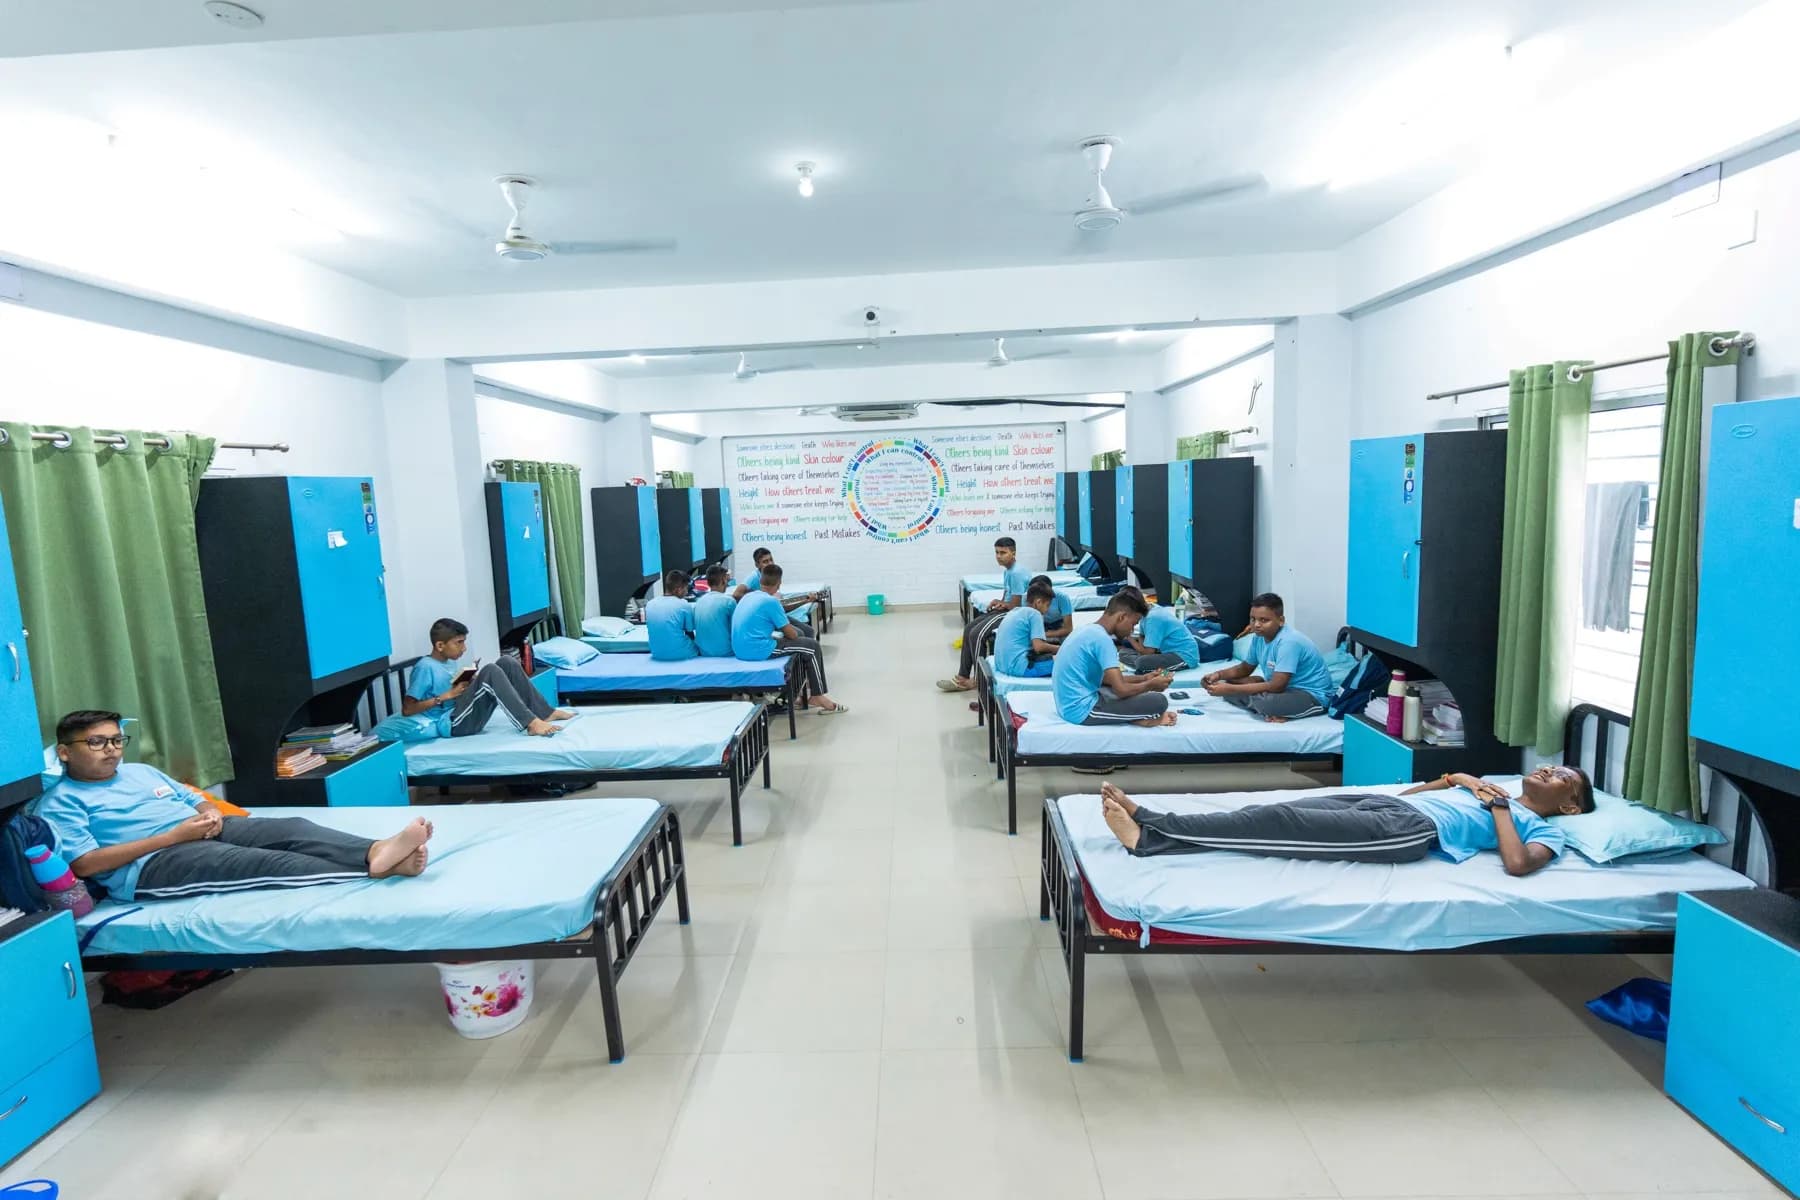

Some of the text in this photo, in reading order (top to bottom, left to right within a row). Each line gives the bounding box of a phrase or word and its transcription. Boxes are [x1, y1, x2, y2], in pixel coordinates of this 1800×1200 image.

[914, 437, 929, 450] What
[1013, 443, 1054, 456] Skin colour
[804, 452, 844, 465] Skin colour
[865, 452, 880, 464] What
[901, 448, 925, 462] control
[945, 446, 1009, 460] Others being kind
[737, 454, 800, 469] Others being kind
[951, 464, 972, 472] Others
[974, 463, 992, 474] taking
[1020, 460, 1054, 470] themselves
[738, 472, 759, 482] Others
[760, 471, 779, 484] taking
[806, 470, 840, 479] themselves
[983, 479, 998, 488] How
[1000, 476, 1022, 486] others
[1024, 476, 1041, 486] treat
[764, 488, 780, 497] How
[783, 486, 803, 496] others
[804, 485, 823, 494] treat
[956, 479, 976, 491] Height
[738, 488, 758, 500] Height
[1025, 492, 1039, 501] keeps
[1040, 490, 1055, 500] trying
[814, 501, 828, 510] keeps
[829, 500, 844, 509] trying
[947, 508, 964, 516] Others
[871, 519, 887, 530] What
[936, 522, 1001, 536] Others being honest
[1008, 520, 1055, 531] Past Mistakes
[742, 530, 807, 544] Others being honest
[814, 528, 861, 539] Past Mistakes
[866, 532, 889, 543] control
[914, 530, 930, 538] What
